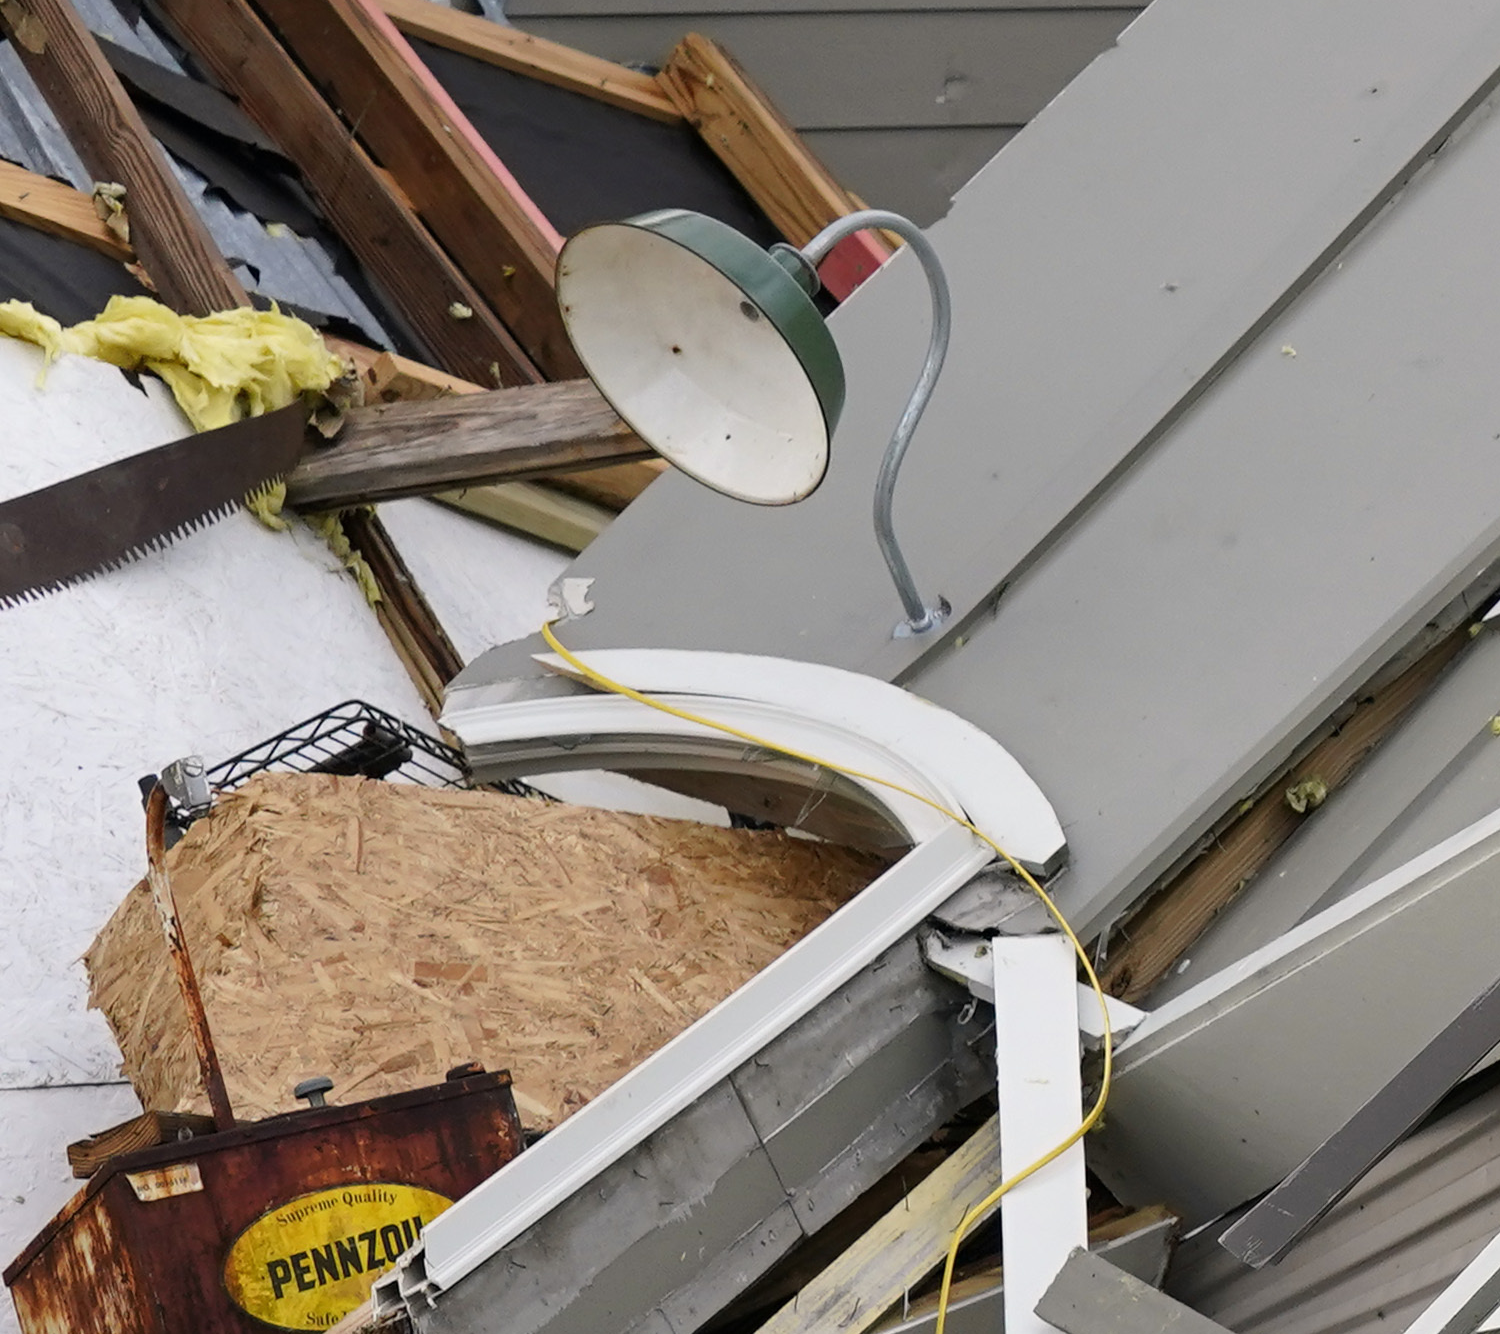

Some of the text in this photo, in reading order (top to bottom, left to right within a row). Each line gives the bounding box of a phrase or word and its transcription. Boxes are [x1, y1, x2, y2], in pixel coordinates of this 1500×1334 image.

[277, 1189, 397, 1226] Supreme Quality
[306, 1312, 339, 1326] Safe
